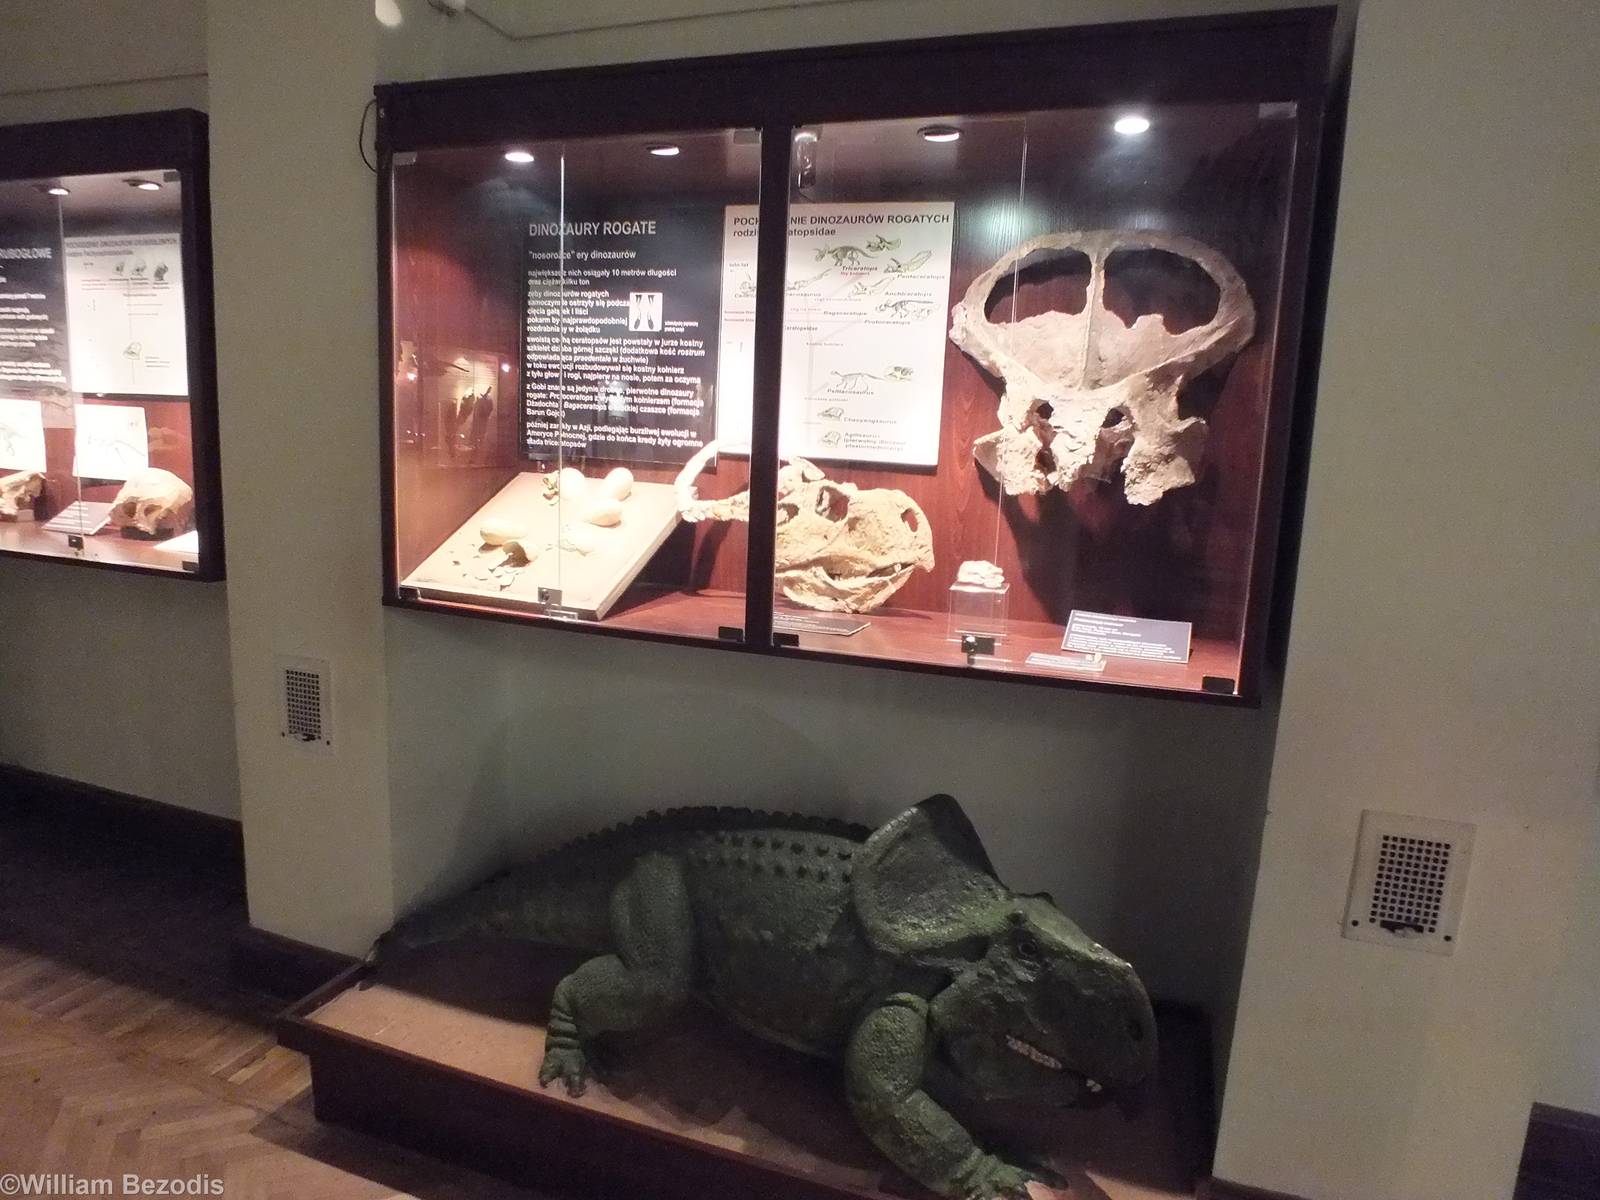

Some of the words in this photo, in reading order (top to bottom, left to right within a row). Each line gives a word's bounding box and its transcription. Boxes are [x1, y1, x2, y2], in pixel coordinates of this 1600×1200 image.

[810, 213, 884, 224] DINOZAURÓW
[887, 213, 949, 224] ROGATYCH
[529, 222, 600, 236] DINOZAURY
[603, 221, 656, 235] ROGATE
[576, 251, 588, 261] ery
[590, 250, 636, 259] dinozaurów
[612, 268, 620, 276] 10
[621, 268, 646, 277] metrów
[647, 268, 677, 278] długości
[543, 290, 580, 298] dinozurów
[581, 290, 610, 299] rogatych
[595, 299, 605, 308] się
[606, 298, 630, 308] podcza
[527, 316, 551, 325] pokarm
[572, 337, 609, 346] ceratopsów
[609, 338, 622, 346] jest
[623, 338, 653, 347] powstały
[661, 338, 679, 347] jurze
[680, 339, 704, 349] kostny
[527, 345, 550, 353] szkielet
[573, 345, 594, 355] górnej
[620, 346, 658, 355] (dodatkowa
[660, 347, 676, 356] kość
[677, 349, 706, 357] rostrum
[575, 363, 622, 373] rozbudowywał
[622, 365, 632, 373] się
[633, 365, 657, 374] kostny
[657, 365, 685, 375] kołnierz
[531, 370, 544, 379] tyłu
[583, 372, 611, 381] najpierw
[612, 372, 620, 380] na
[643, 373, 664, 383] potem
[674, 376, 702, 385] oczyma
[531, 382, 547, 390] Gobi
[567, 385, 575, 393] są
[575, 385, 599, 394] jedynie
[626, 387, 659, 396] pierwotne
[660, 388, 695, 398] dinozaury
[633, 396, 671, 405] kołnierzem
[671, 397, 705, 408] (formacja
[527, 408, 546, 416] Barun
[564, 401, 607, 411] Bagaceratops
[667, 406, 700, 417] (formacja
[527, 421, 549, 430] później
[593, 425, 629, 435] podlegając
[630, 426, 660, 437] burzliwej
[661, 428, 689, 439] ewolucji
[527, 429, 553, 437] Ameryce
[588, 432, 605, 442] gdzie
[616, 434, 636, 443] końca
[637, 435, 656, 446] kredy
[657, 437, 671, 447] żyły
[672, 439, 704, 448] ogromne
